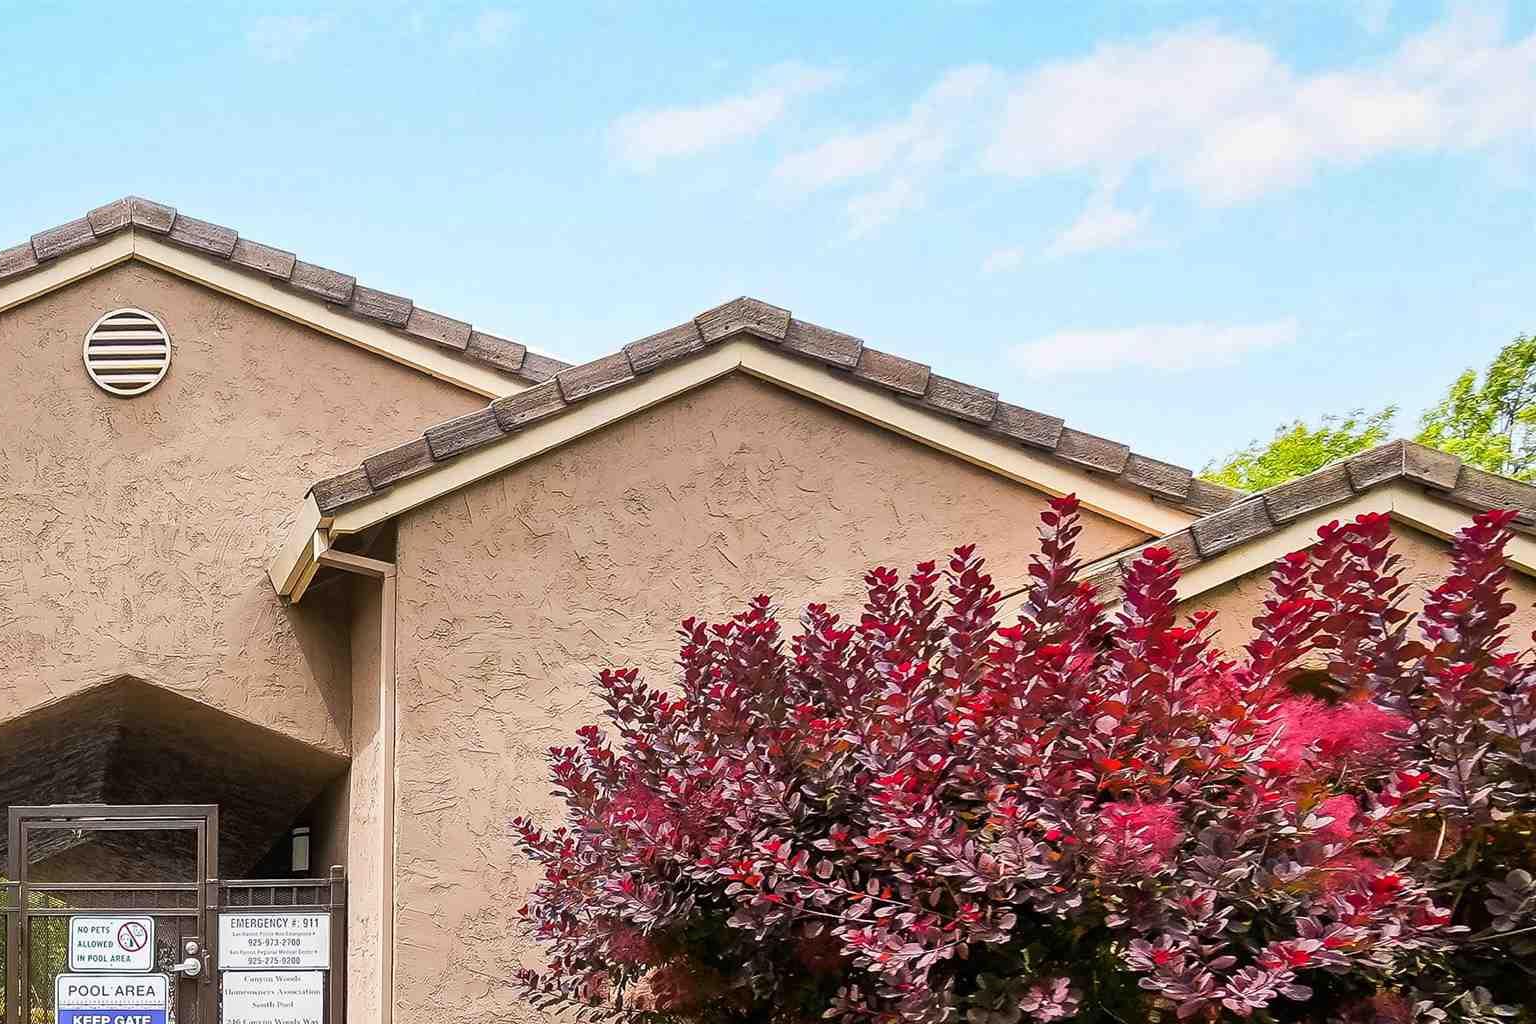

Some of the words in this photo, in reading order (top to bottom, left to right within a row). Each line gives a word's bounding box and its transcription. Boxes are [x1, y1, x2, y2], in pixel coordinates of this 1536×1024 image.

[230, 918, 288, 928] EMERGENCY
[302, 918, 319, 928] 911
[77, 926, 88, 934] NO
[90, 926, 110, 934] PETS
[77, 940, 114, 948] ALLOWED
[68, 985, 109, 997] POOL
[114, 985, 155, 997] AREA
